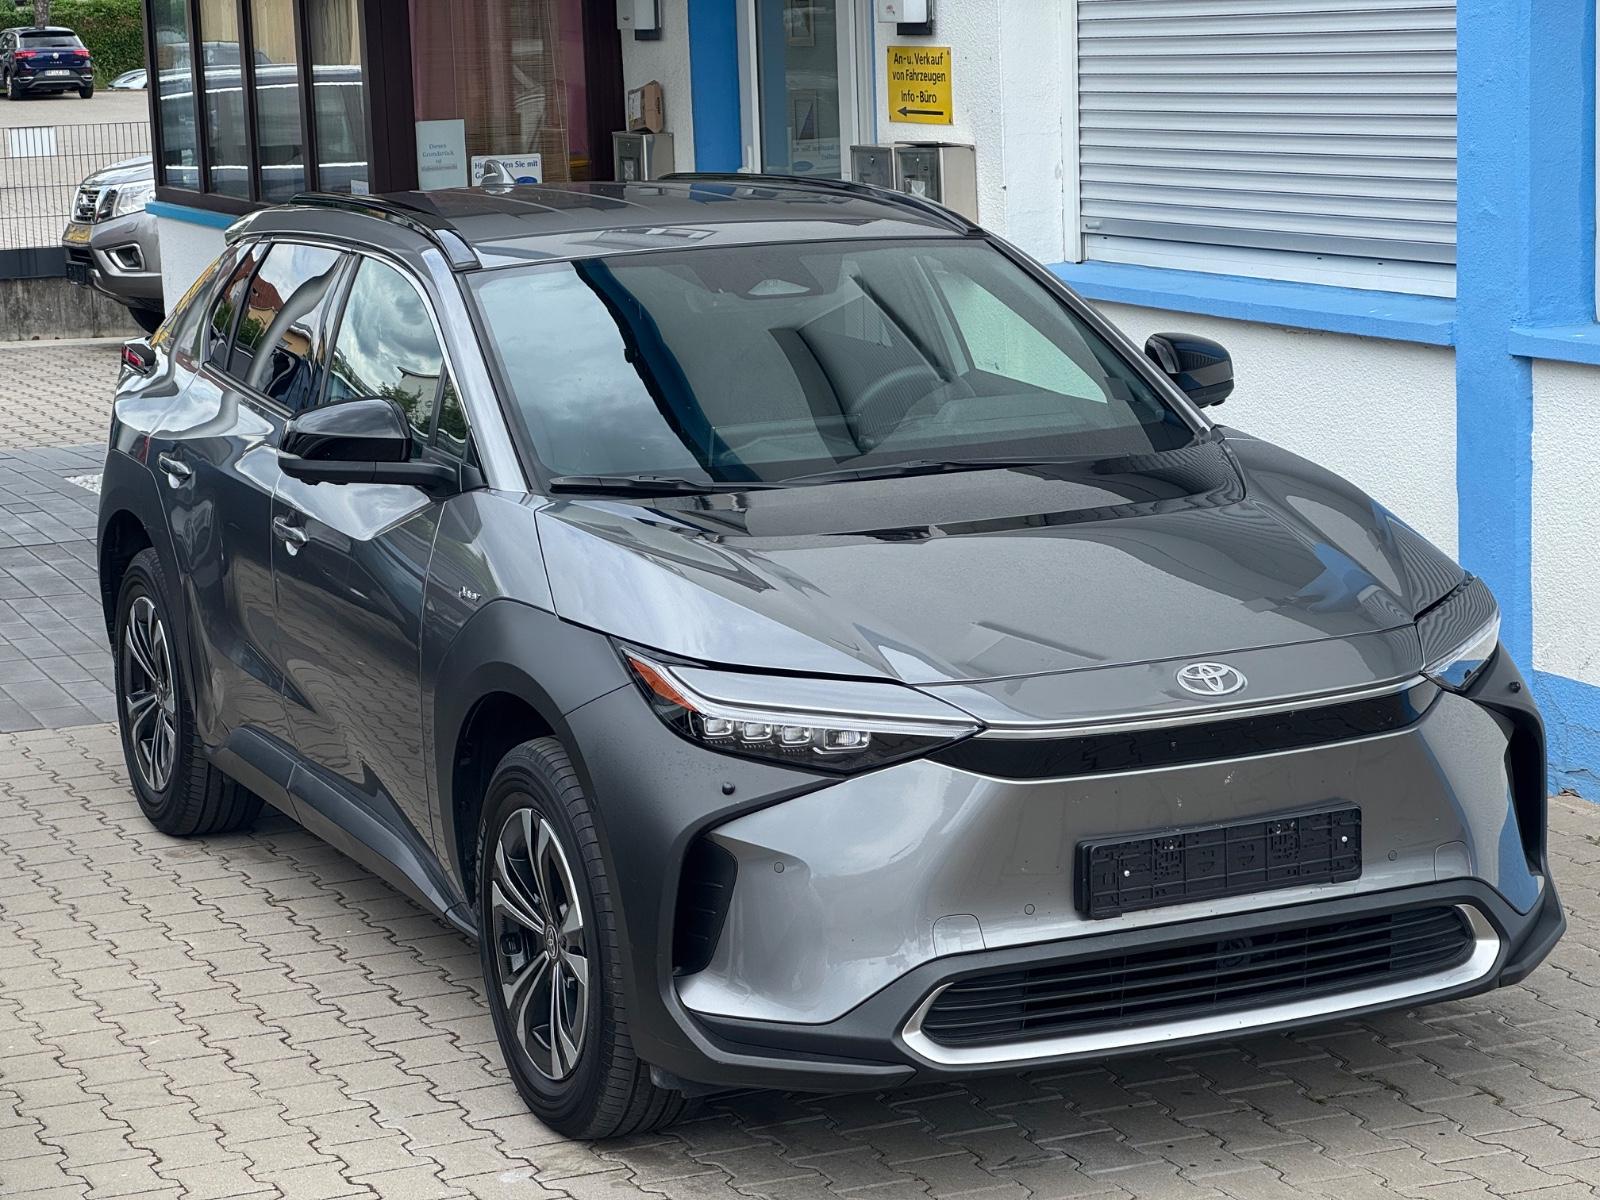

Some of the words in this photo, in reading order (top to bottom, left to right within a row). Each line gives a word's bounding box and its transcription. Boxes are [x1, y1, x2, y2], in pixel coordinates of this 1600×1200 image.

[914, 52, 944, 66] Verkauf
[892, 71, 905, 81] von
[905, 68, 946, 85] Fahrzeugen
[514, 160, 526, 168] Sie
[526, 160, 539, 168] mit
